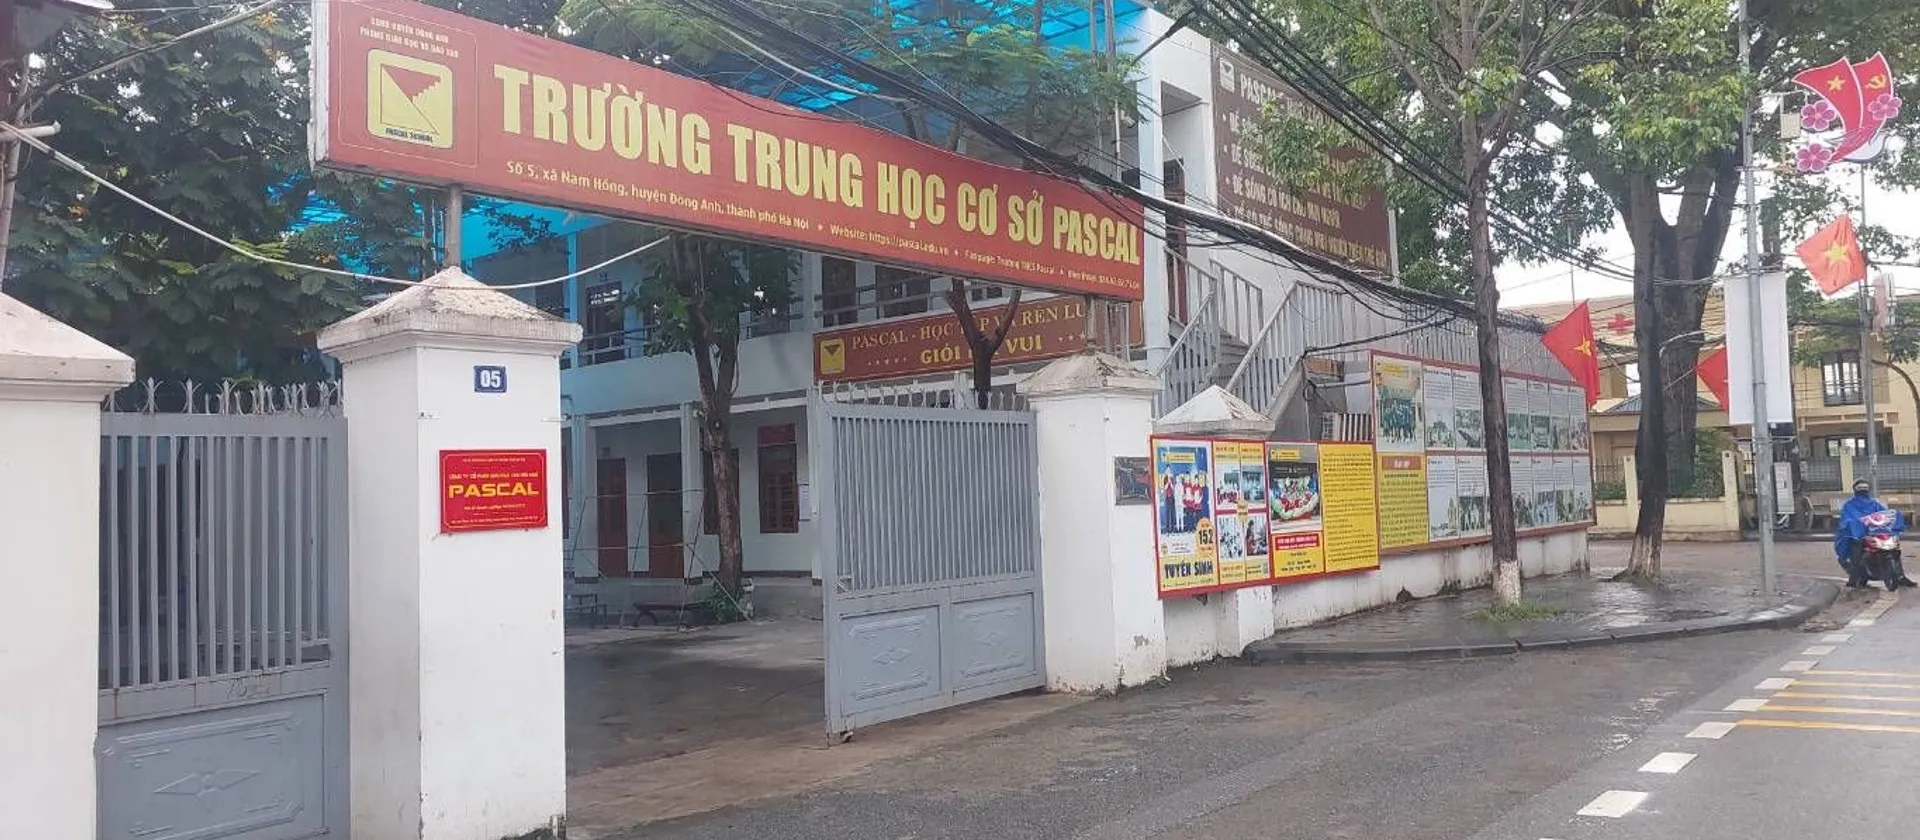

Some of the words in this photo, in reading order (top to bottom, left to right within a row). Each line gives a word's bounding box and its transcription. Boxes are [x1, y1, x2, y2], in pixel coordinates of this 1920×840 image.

[494, 64, 711, 175] TRƯỜNG
[727, 123, 864, 207] TRUNG
[877, 161, 945, 230] HỌC
[957, 182, 999, 236] CƠ
[1008, 189, 1044, 245] SỞ
[1053, 206, 1140, 265] PASCAL
[561, 170, 590, 188] Nam
[852, 330, 909, 350] PASCAL
[1005, 335, 1042, 355] VUI
[480, 370, 501, 388] 05
[449, 482, 539, 499] PASCAL
[1199, 529, 1213, 545] 152
